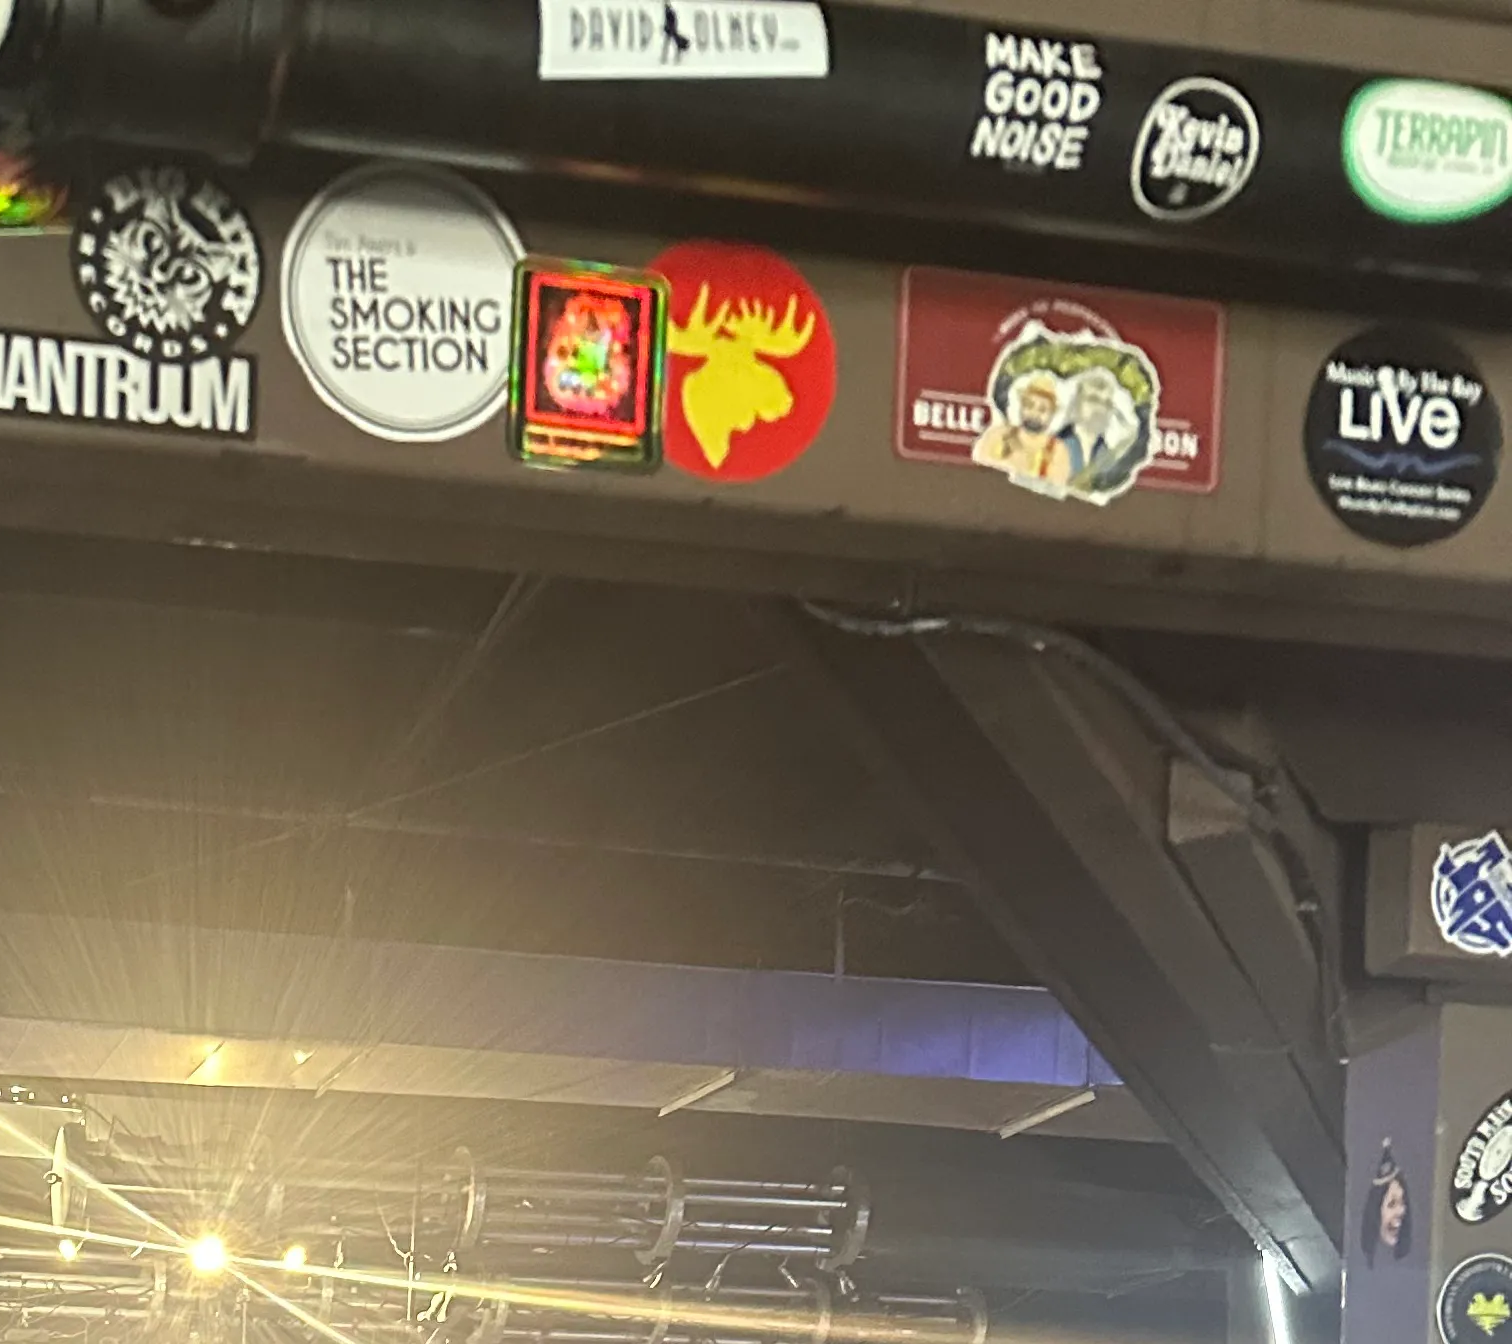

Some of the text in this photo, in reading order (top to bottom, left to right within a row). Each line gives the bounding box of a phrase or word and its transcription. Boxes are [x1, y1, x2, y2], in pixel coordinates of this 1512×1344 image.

[569, 7, 655, 51] DAVID
[985, 31, 1103, 80] MAKE
[984, 69, 1101, 123] GOOD
[970, 115, 1089, 171] NOISE
[1375, 107, 1509, 168] TERRAPIN
[326, 256, 389, 294] THE
[330, 297, 502, 335] SMOKING
[332, 336, 489, 373] SECTION
[913, 400, 987, 434] BELLE
